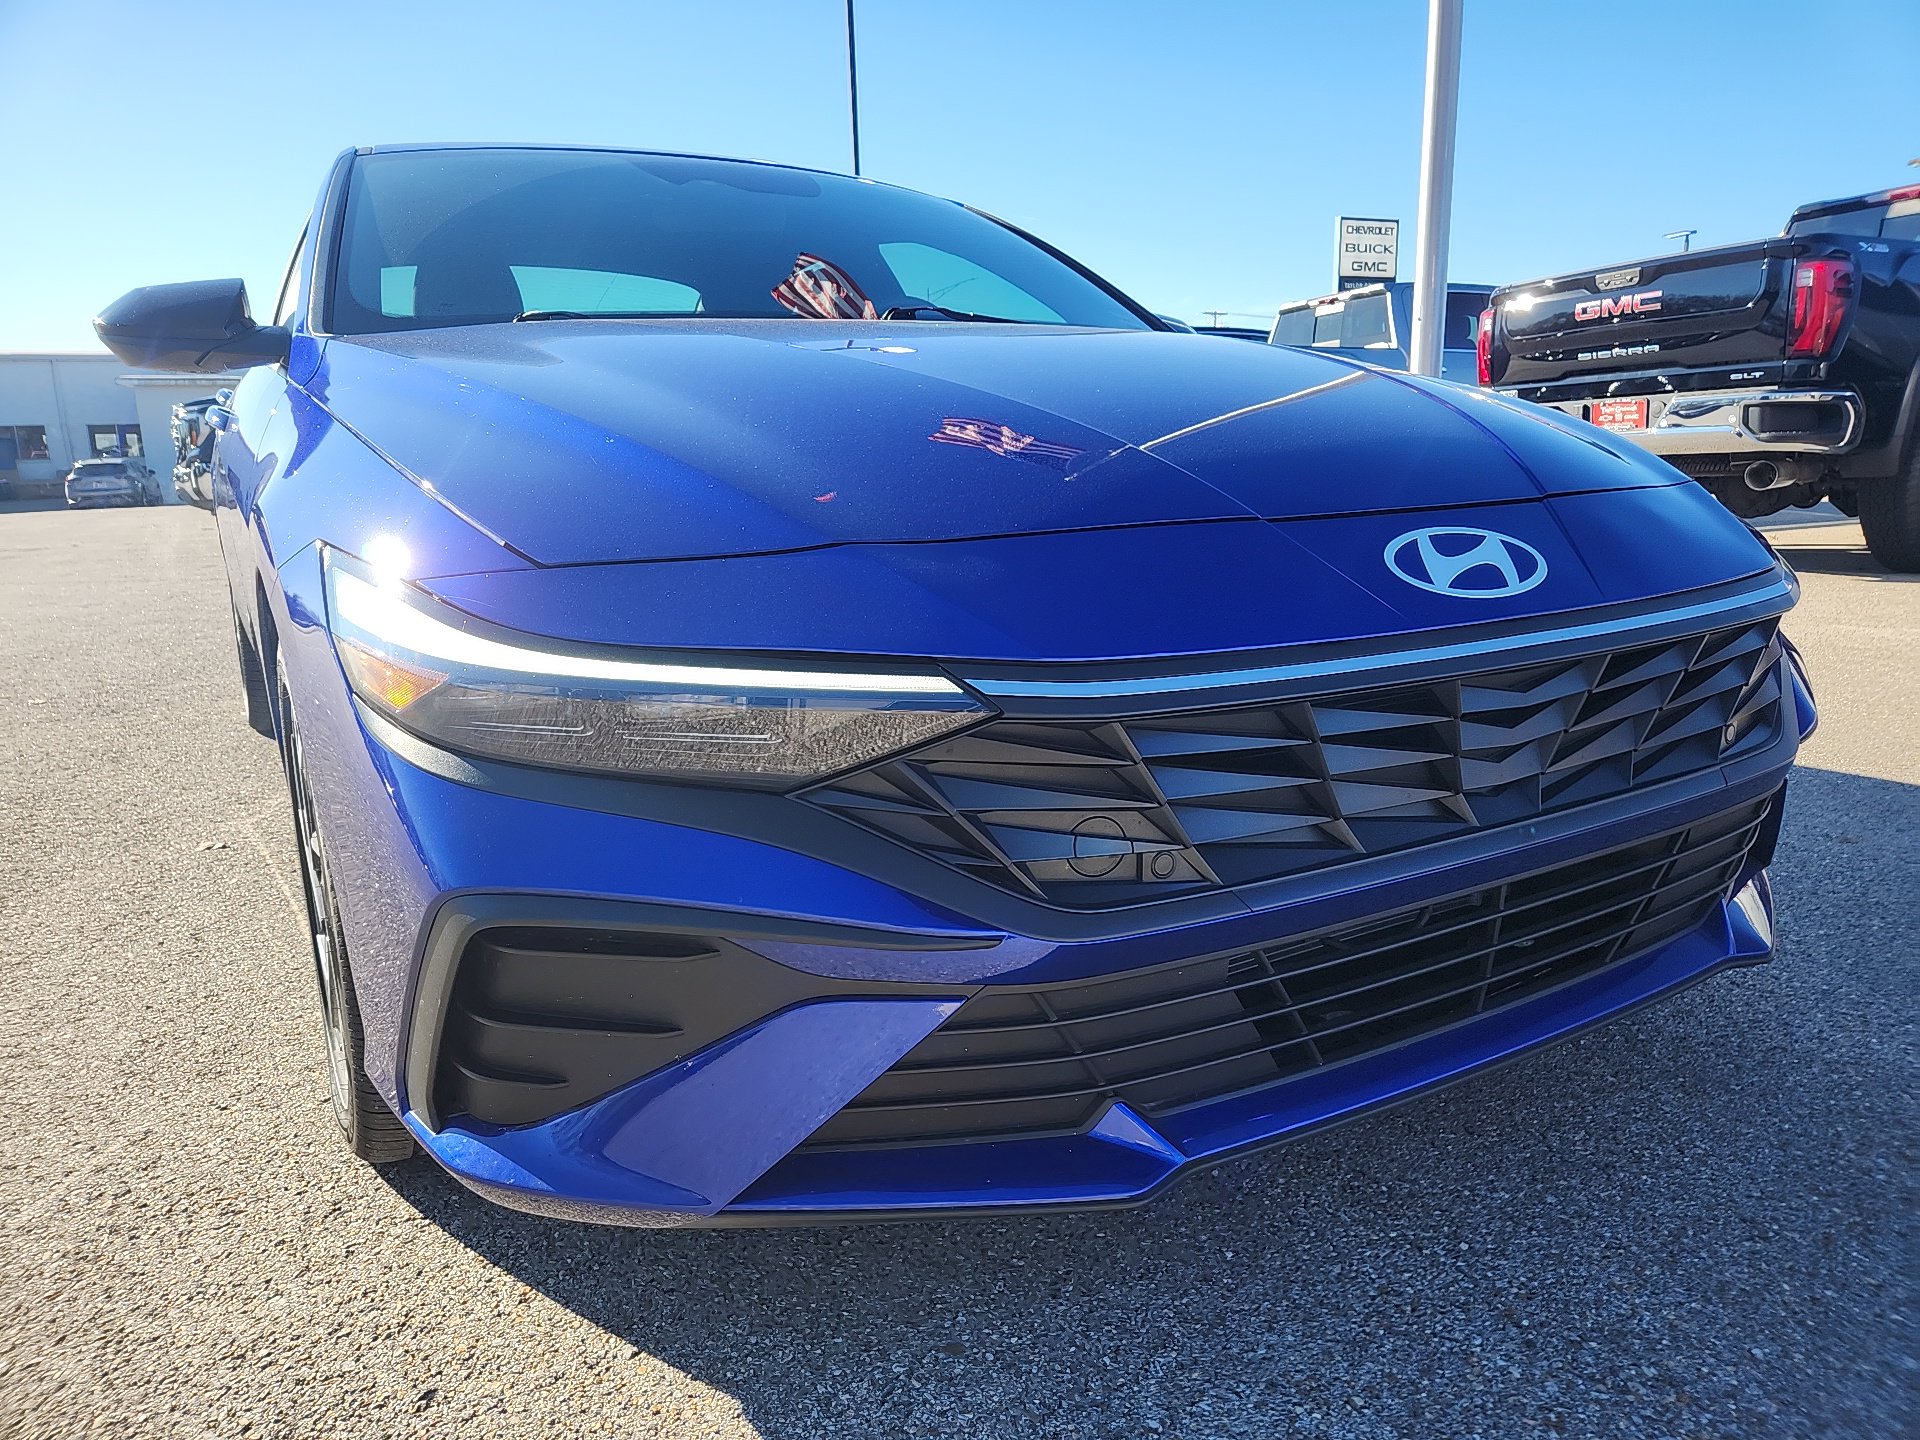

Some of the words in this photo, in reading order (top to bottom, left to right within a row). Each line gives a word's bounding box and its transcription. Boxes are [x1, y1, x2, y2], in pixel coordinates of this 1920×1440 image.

[1346, 225, 1395, 236] CHEVROLET
[1345, 243, 1394, 254] BUICK
[1351, 261, 1388, 272] GMC
[1574, 290, 1664, 321] GMC
[1577, 344, 1660, 361] SIERRA
[1729, 371, 1765, 380] SLT
